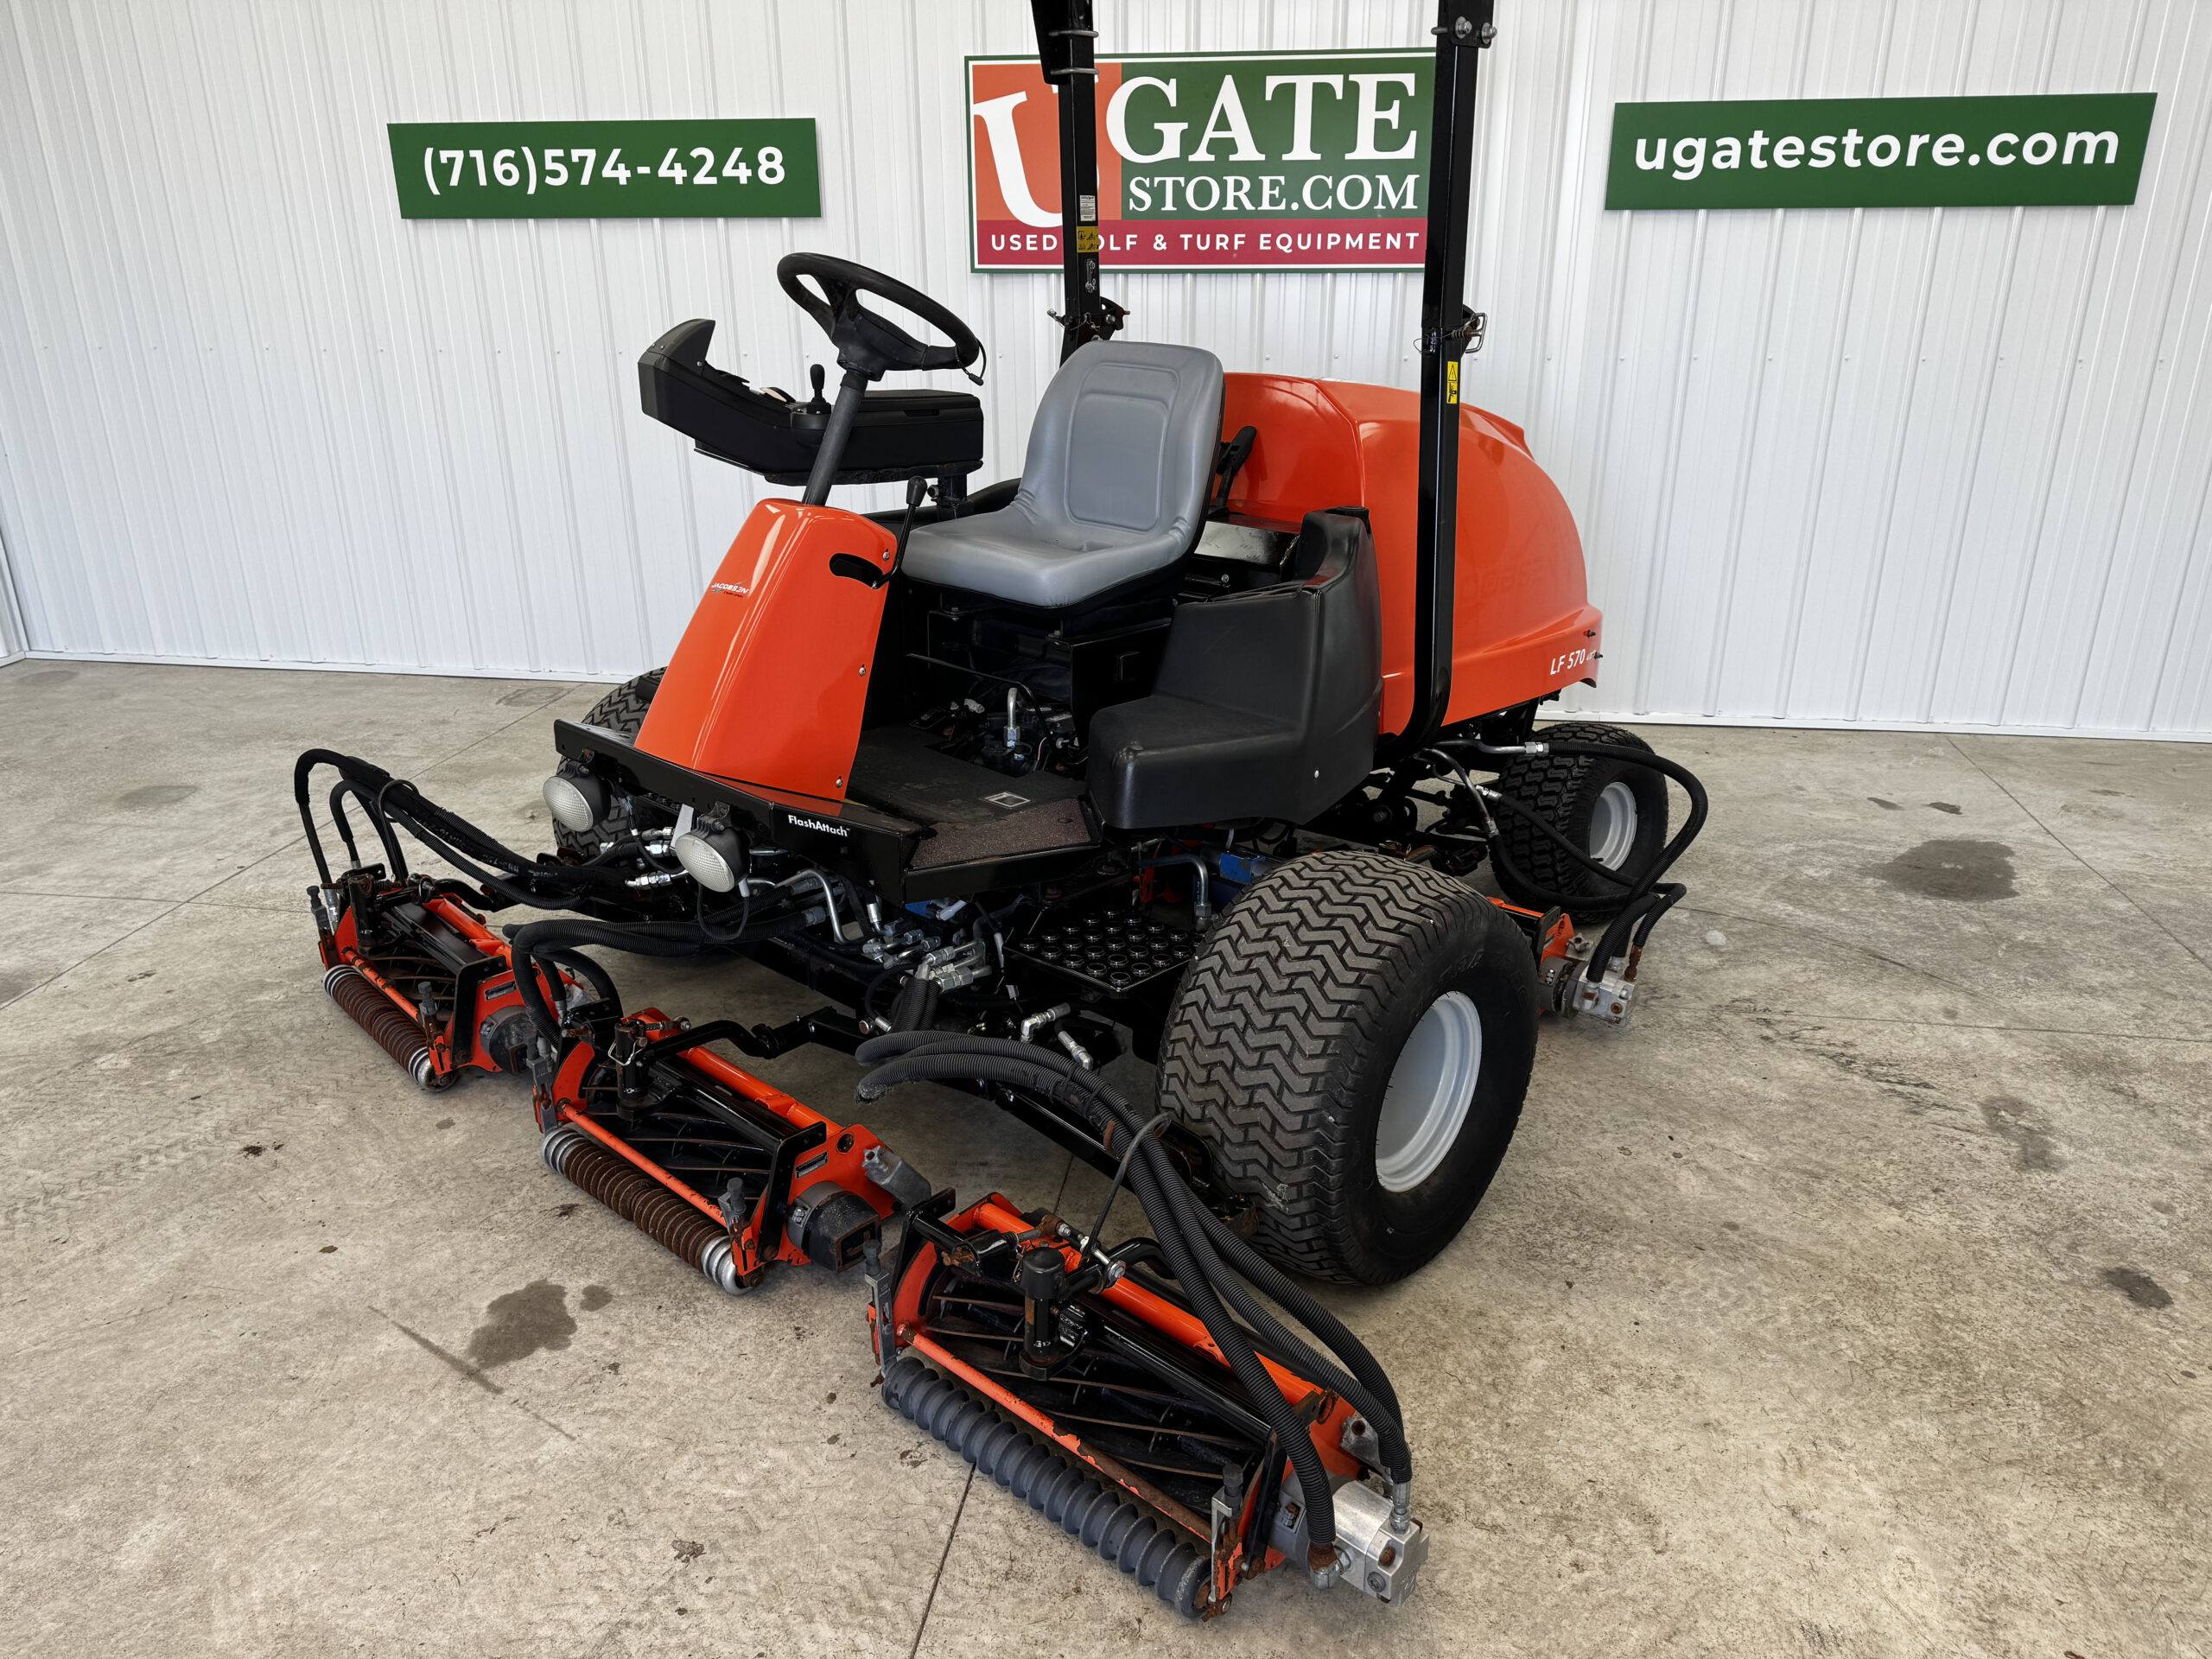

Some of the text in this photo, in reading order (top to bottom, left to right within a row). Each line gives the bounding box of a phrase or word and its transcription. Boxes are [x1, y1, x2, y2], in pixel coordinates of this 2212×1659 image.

[423, 146, 785, 195] (716)574-4248
[1634, 128, 2120, 181] ugatestore.com
[1128, 174, 1420, 212] STORE.COM
[991, 235, 1058, 251] USED
[1154, 235, 1167, 251] &
[1180, 233, 1246, 251] TURF
[1259, 232, 1419, 251] EQUIPMENT
[711, 582, 749, 594] JACOBSEN
[1549, 654, 1566, 676] LF
[1567, 648, 1586, 670] 570
